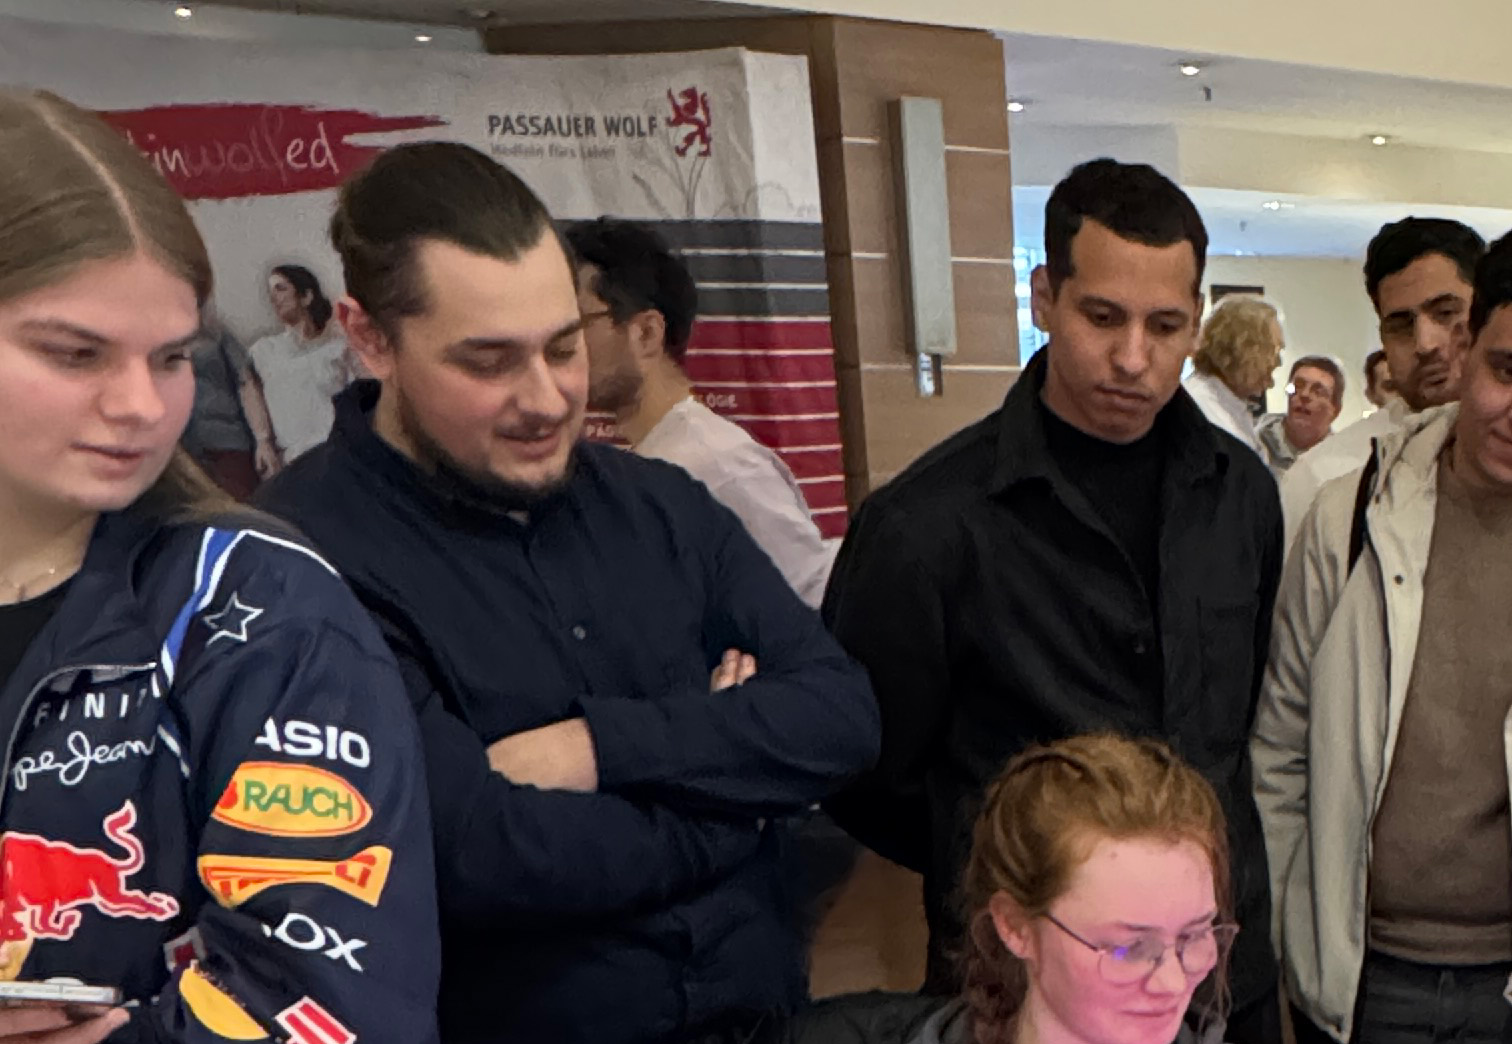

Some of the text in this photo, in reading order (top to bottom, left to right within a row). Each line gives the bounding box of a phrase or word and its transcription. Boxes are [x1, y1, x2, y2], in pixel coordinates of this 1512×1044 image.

[488, 114, 658, 138] PASSAUER WOLF
[242, 779, 354, 822] RAUCH
